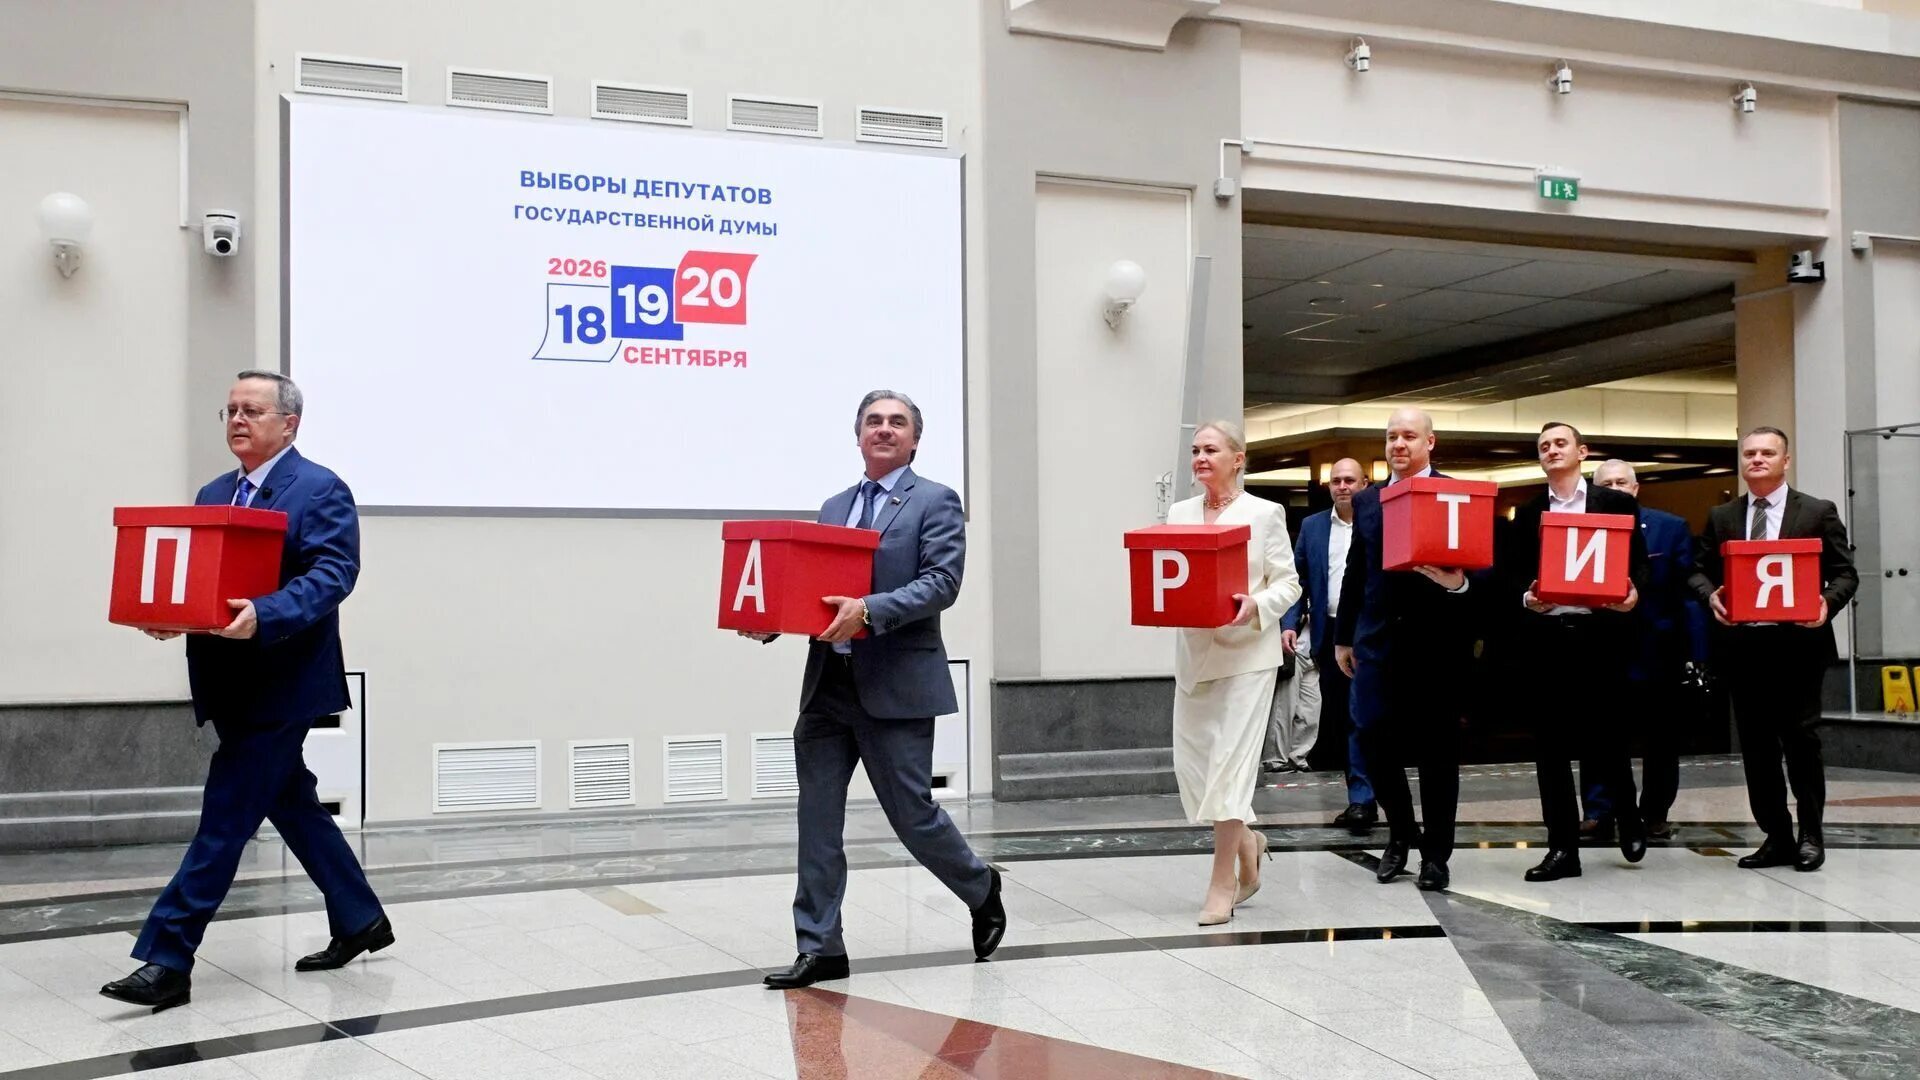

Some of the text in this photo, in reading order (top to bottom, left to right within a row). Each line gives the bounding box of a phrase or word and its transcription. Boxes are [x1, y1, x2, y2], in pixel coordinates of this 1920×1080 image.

[520, 170, 773, 205] ВЫБОРЫ ДЕПУТАТОВ
[514, 205, 778, 236] ГОСУДАРСТВЕННОЙ ДУМЫ
[547, 257, 607, 278] 2026
[555, 266, 742, 345] 18 19 20
[623, 346, 747, 368] СЕНТЯБРЯ
[1436, 493, 1471, 550] Т
[140, 527, 191, 604] П
[732, 539, 766, 613] А
[1152, 549, 1190, 612] Р
[1564, 527, 1608, 584] И
[1755, 554, 1795, 609] Я
